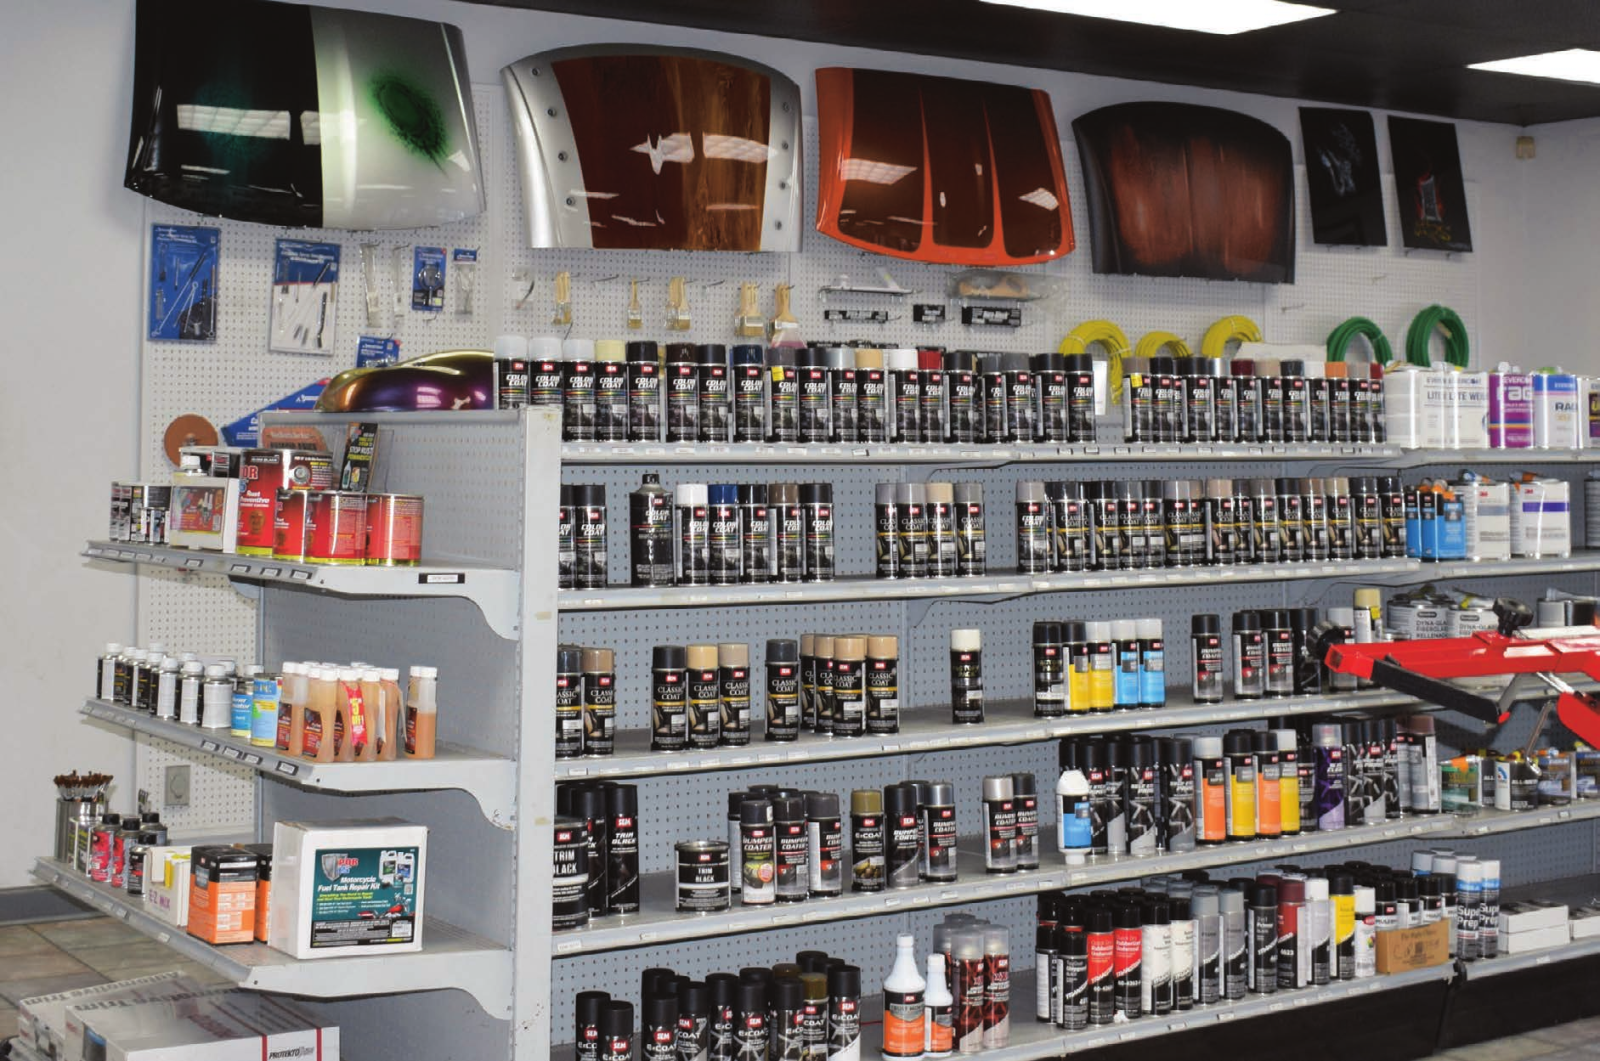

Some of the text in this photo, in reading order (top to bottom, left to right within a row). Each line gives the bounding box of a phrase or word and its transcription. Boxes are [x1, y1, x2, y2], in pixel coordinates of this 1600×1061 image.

[240, 466, 258, 479] OR
[554, 850, 575, 861] TRIM
[1457, 916, 1479, 929] Prep
